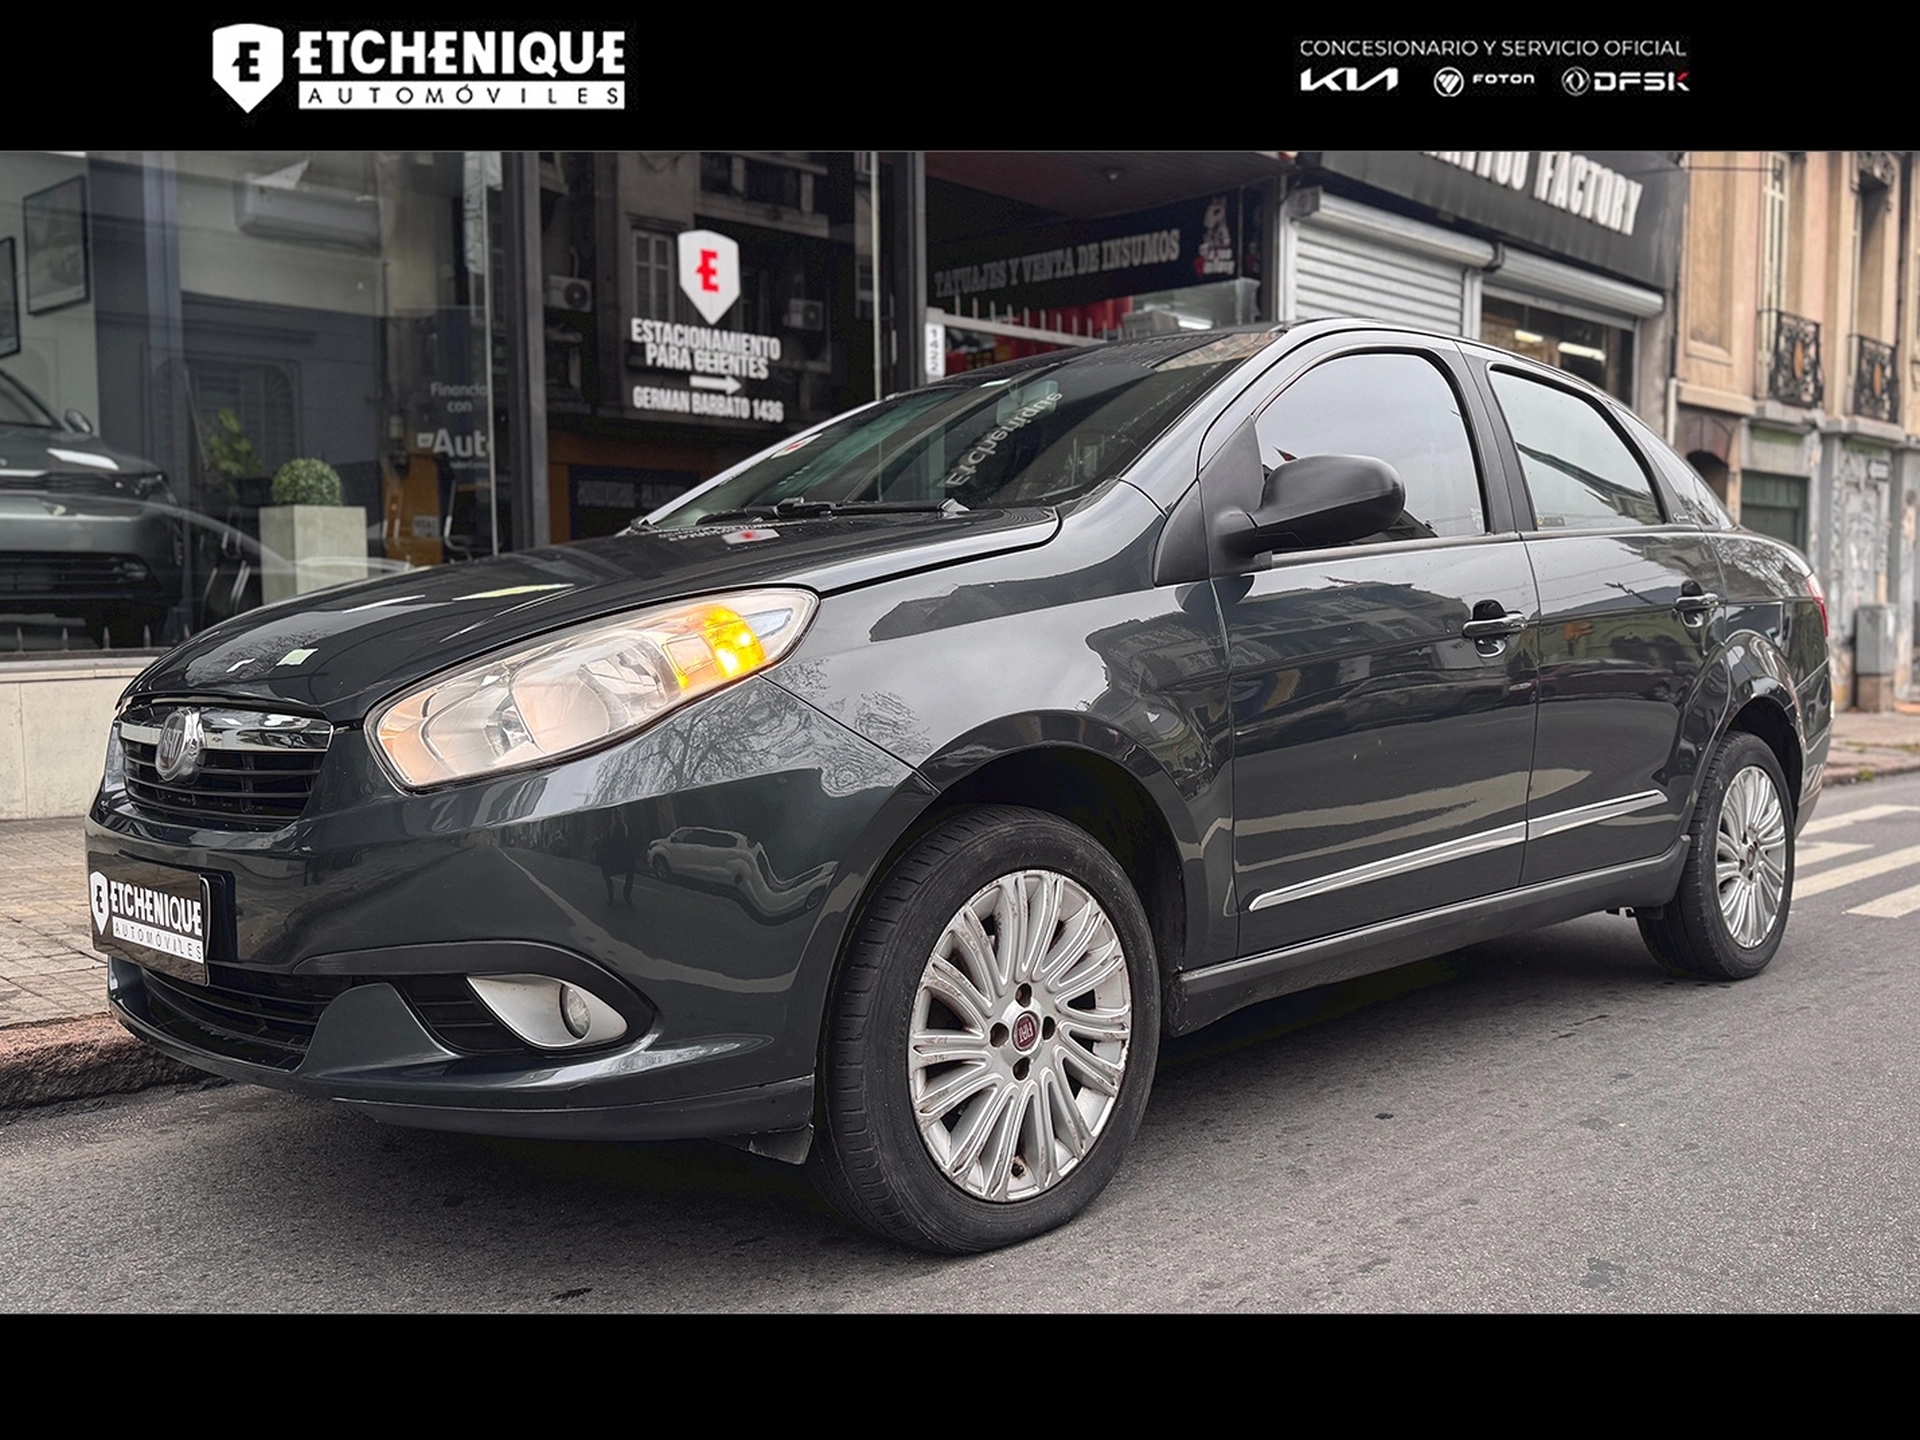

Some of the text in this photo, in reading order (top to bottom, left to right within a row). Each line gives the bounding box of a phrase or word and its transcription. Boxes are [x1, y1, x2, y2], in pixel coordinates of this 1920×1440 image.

[1534, 152, 1643, 236] FACTORY
[935, 260, 1007, 299] TATUAJES
[1009, 258, 1023, 286] Y
[1022, 248, 1075, 284] VENTA
[1077, 242, 1100, 275] DE
[1101, 229, 1180, 272] INSUMOS
[631, 317, 781, 361] ESTACIONAMIENTO
[646, 343, 769, 380] PARA CLIENTES
[447, 400, 473, 414] con
[633, 385, 690, 413] GERMAN
[692, 391, 750, 420] BARBATO
[433, 427, 492, 457] Aut
[110, 880, 203, 937] ETCHENIQUE
[115, 922, 202, 960] AUTOMÓVILES
